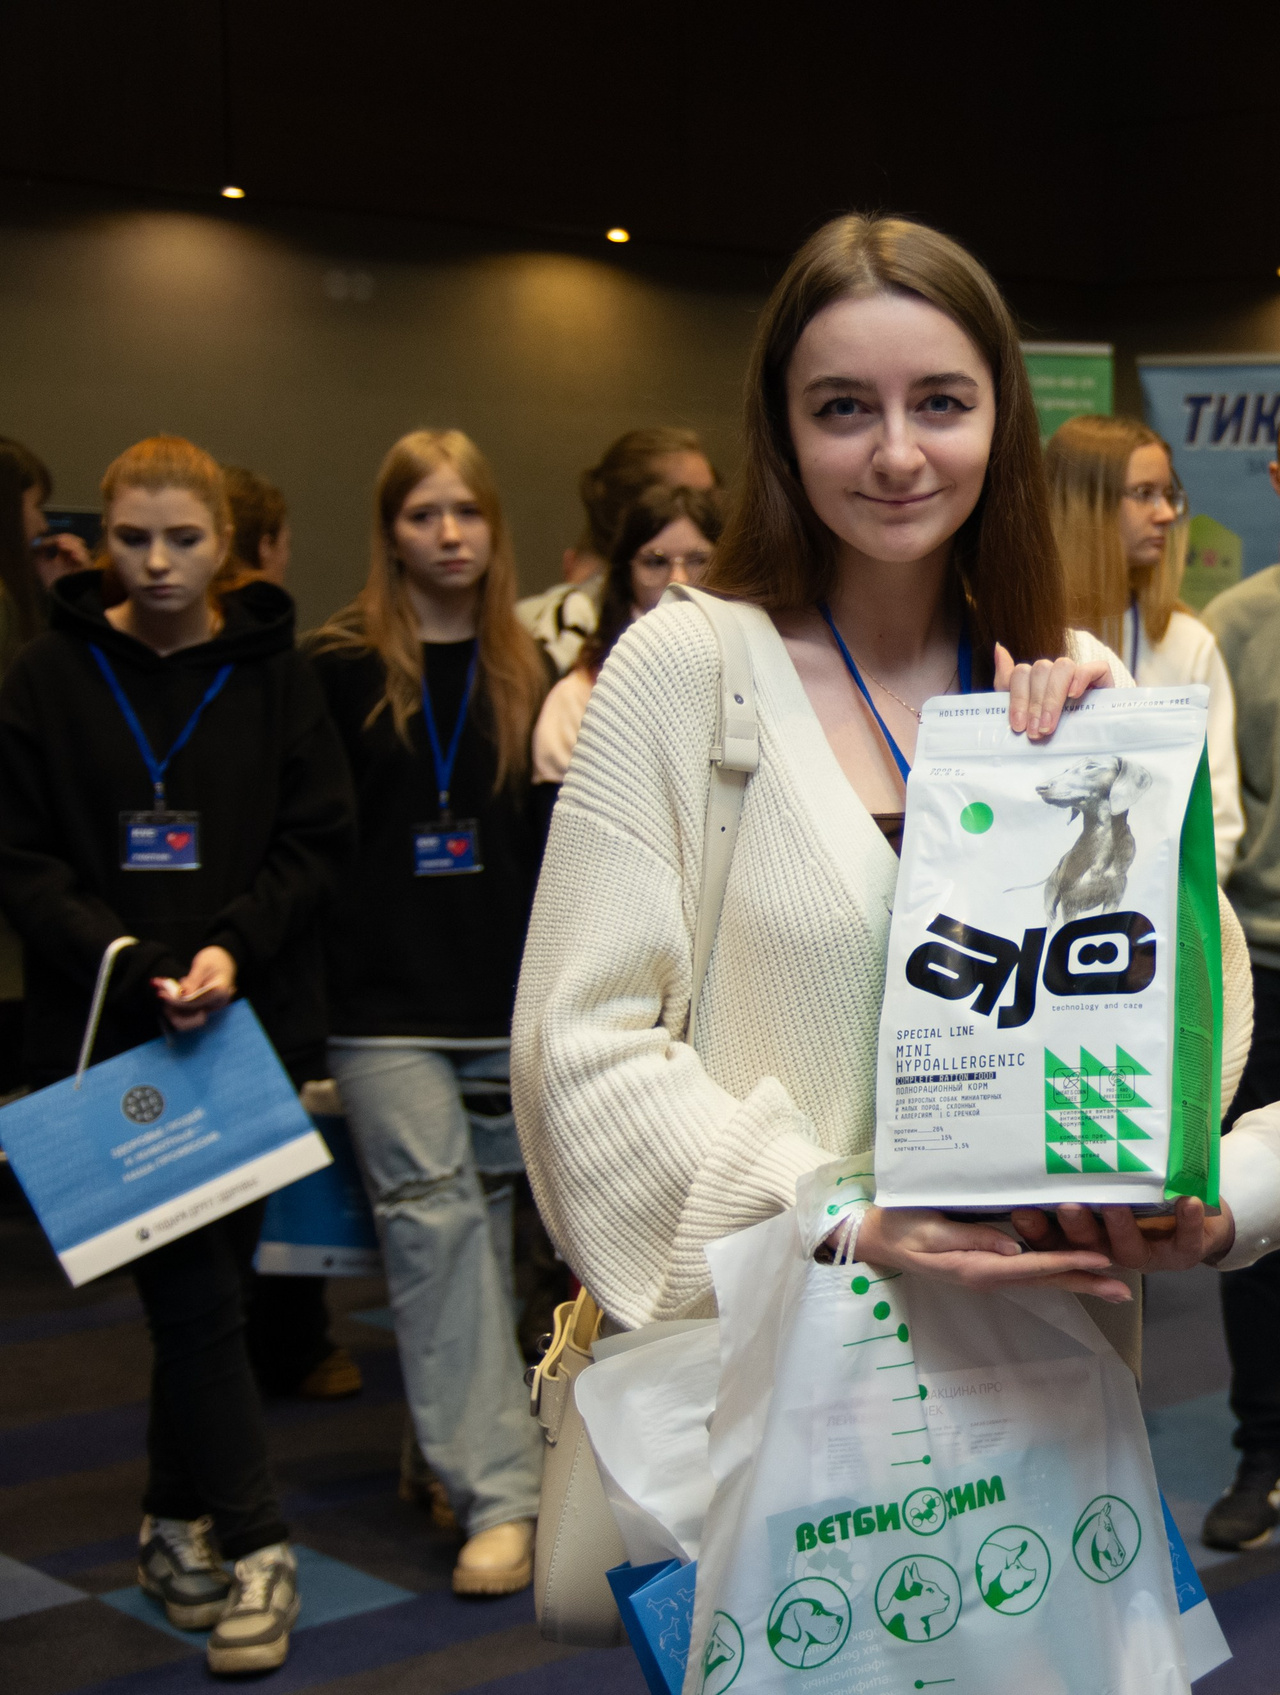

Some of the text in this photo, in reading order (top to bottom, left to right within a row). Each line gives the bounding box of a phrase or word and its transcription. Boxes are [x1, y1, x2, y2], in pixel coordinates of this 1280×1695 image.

[939, 708, 980, 717] HOLISTIC
[985, 707, 1006, 715] VIEW
[1062, 703, 1096, 712] KWHEAT
[1169, 697, 1190, 705] FREE
[1052, 1003, 1099, 1011] technology
[896, 1025, 975, 1040] SPECIAL LINE
[896, 1043, 932, 1058] MINI
[896, 1052, 1026, 1073] HYPOALLERGENIC
[896, 1071, 994, 1085] COMPLETE RATION FOOD
[896, 1082, 989, 1095] ПОЛНОРАЦИОННЫЙ КОРМ
[939, 1095, 958, 1103] СОБАК
[926, 1384, 977, 1401] АКЦИНА
